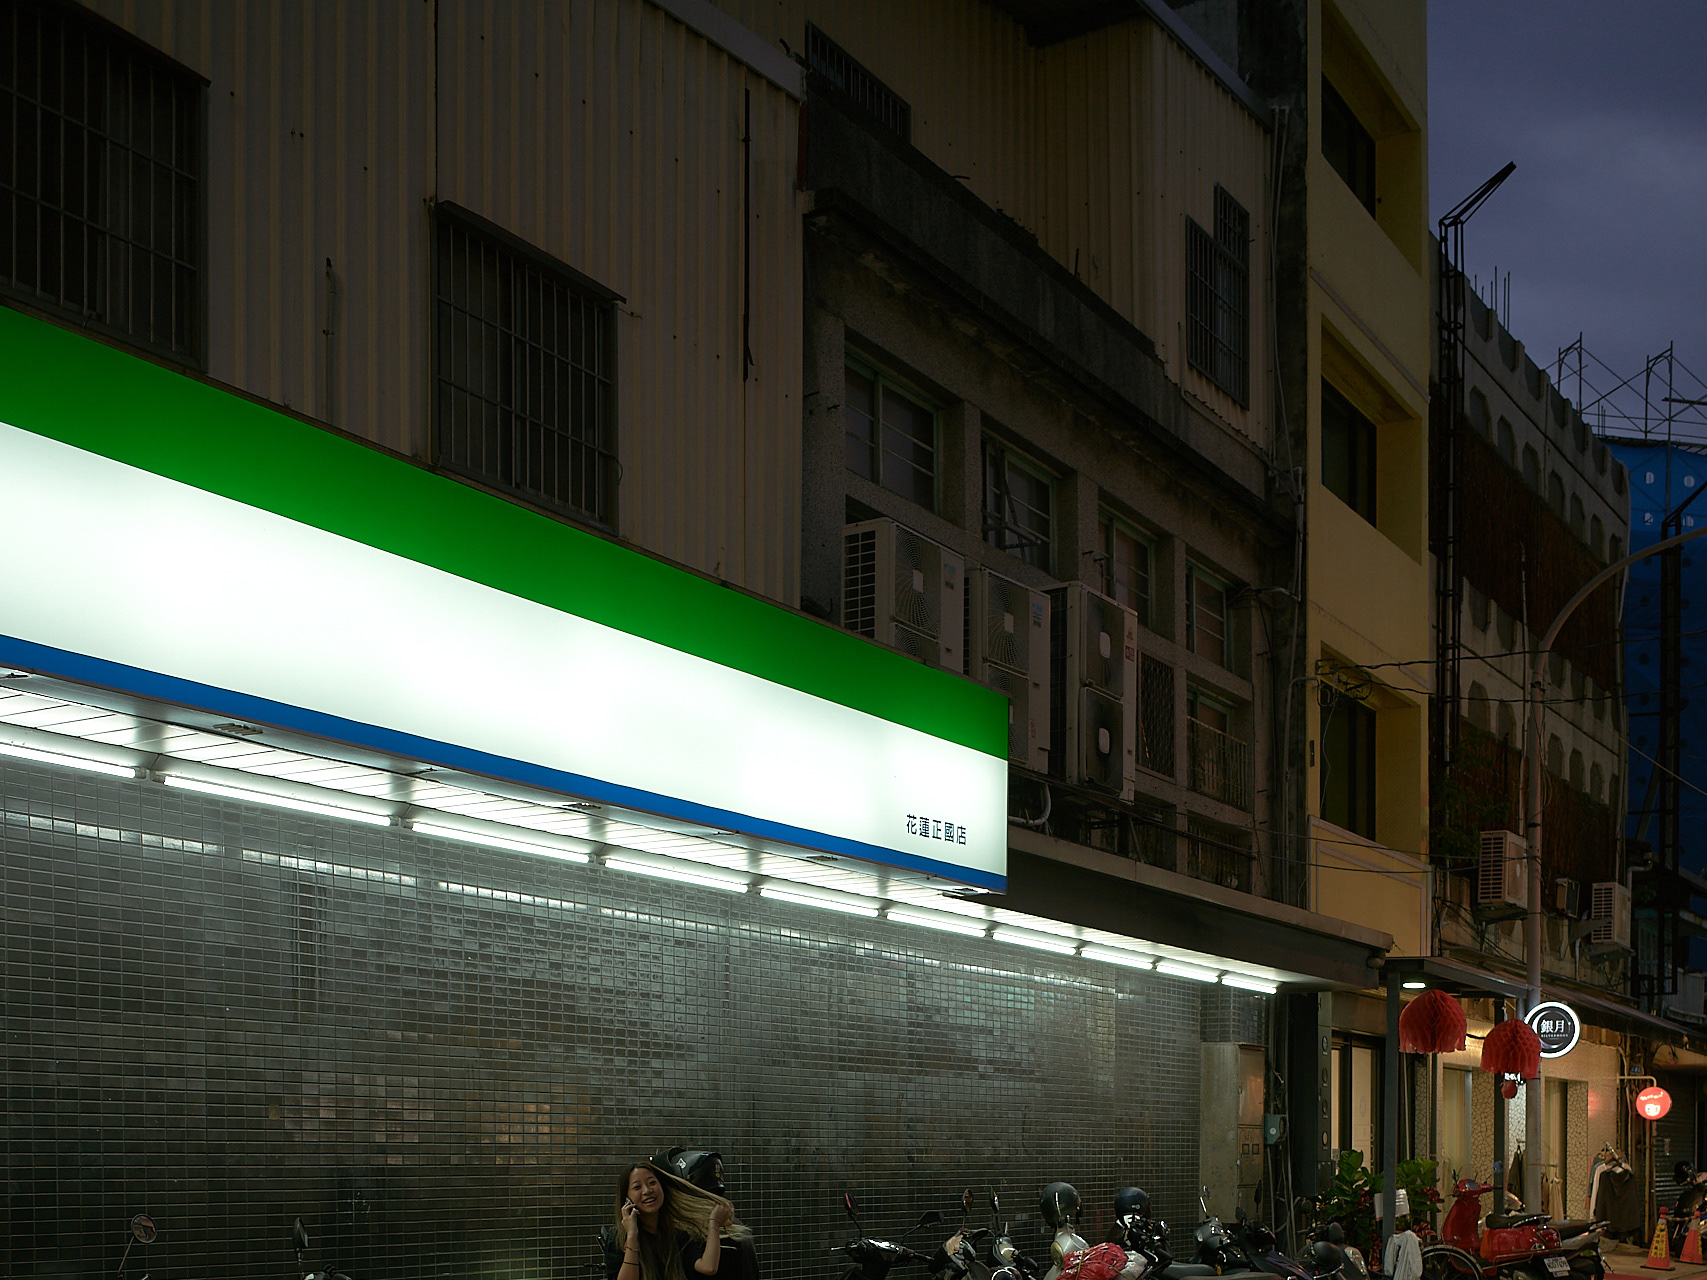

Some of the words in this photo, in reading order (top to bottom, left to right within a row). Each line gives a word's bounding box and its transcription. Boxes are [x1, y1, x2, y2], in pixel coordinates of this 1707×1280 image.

[906, 814, 967, 846] 花蓮正國店
[1540, 1019, 1565, 1033] 銀月
